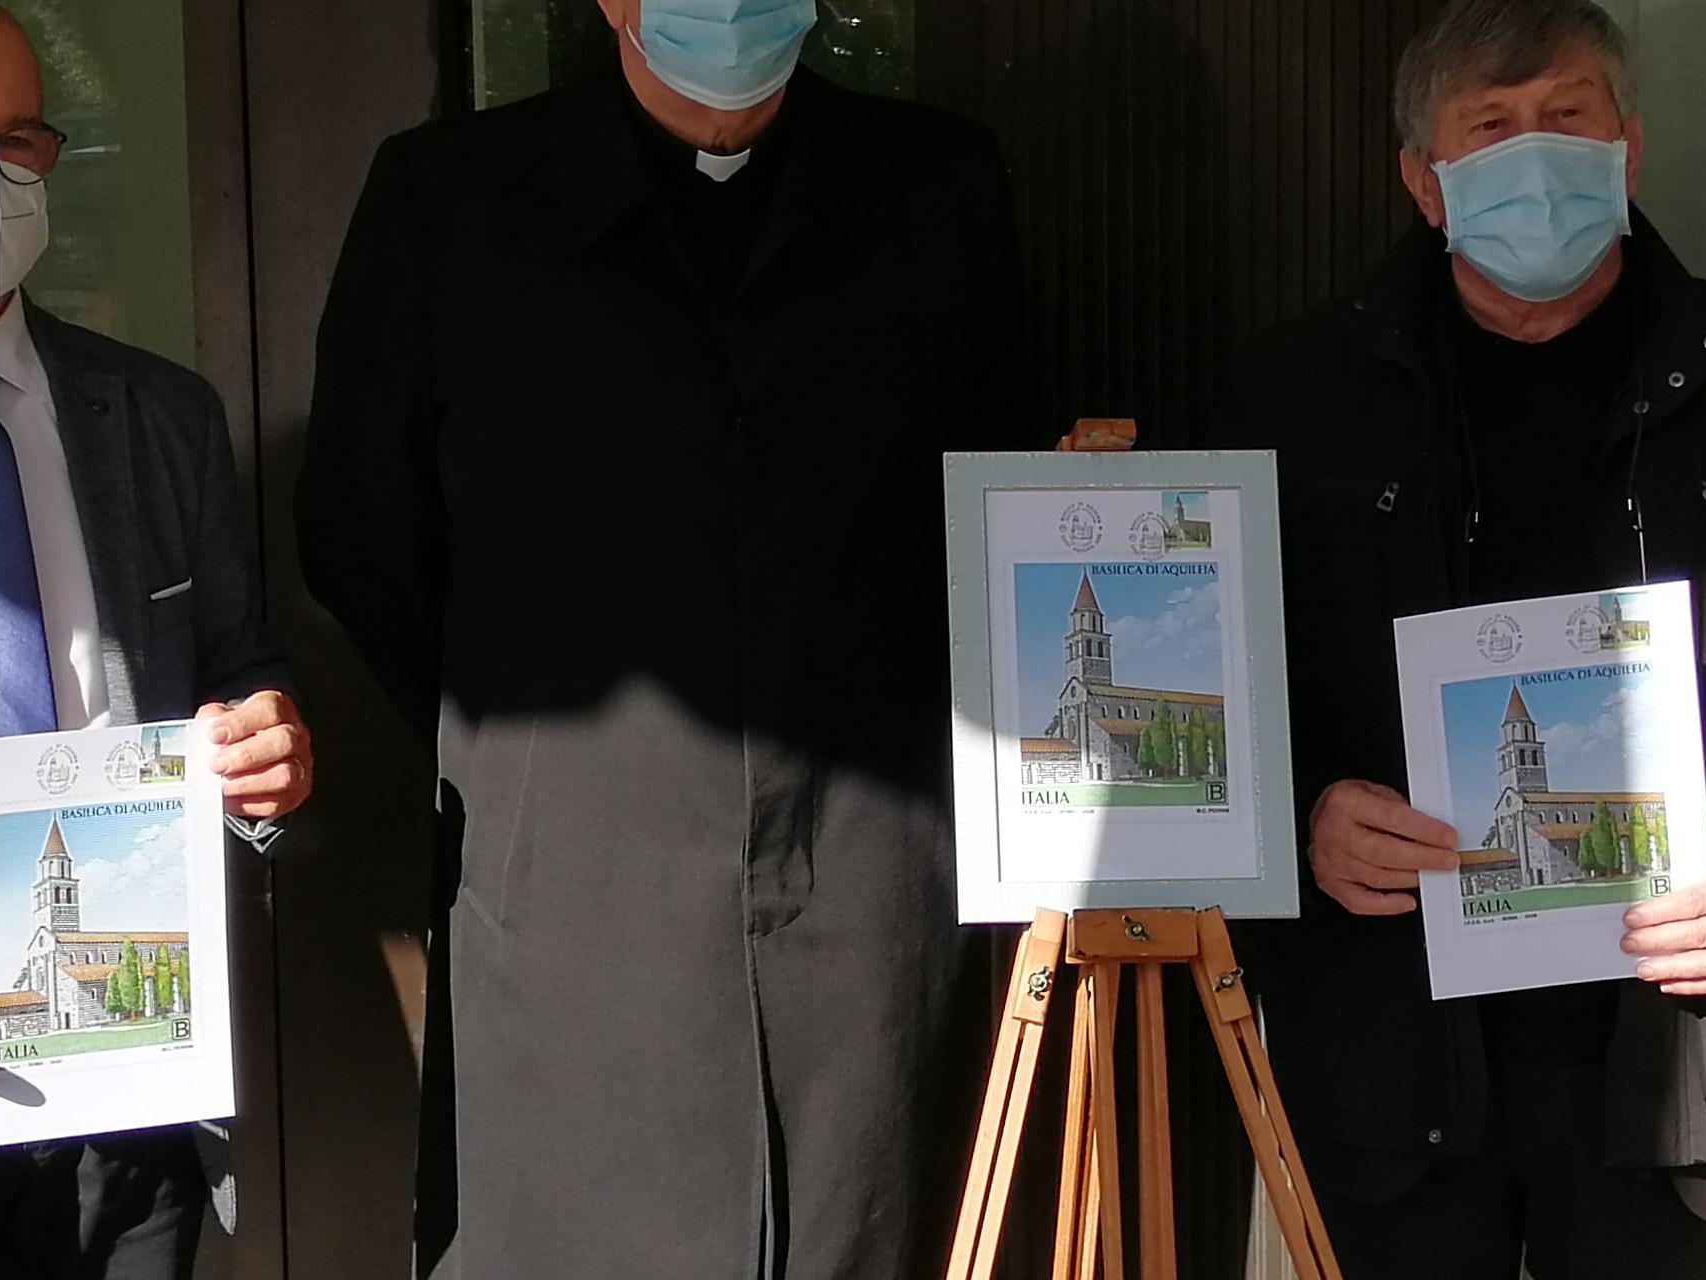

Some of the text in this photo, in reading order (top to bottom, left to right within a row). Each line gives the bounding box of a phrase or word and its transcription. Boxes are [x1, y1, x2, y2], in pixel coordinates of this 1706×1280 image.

[1093, 564, 1216, 579] BASILICA DI AQUILEIA
[1521, 663, 1651, 687] BASILICA DI AQUILEIA
[1021, 791, 1070, 805] ITALIA
[1209, 784, 1223, 801] B
[61, 799, 184, 820] BASILICA DI AQUILEIA
[1654, 878, 1669, 895] B
[1462, 899, 1512, 917] ITALIA
[174, 1021, 189, 1038] B
